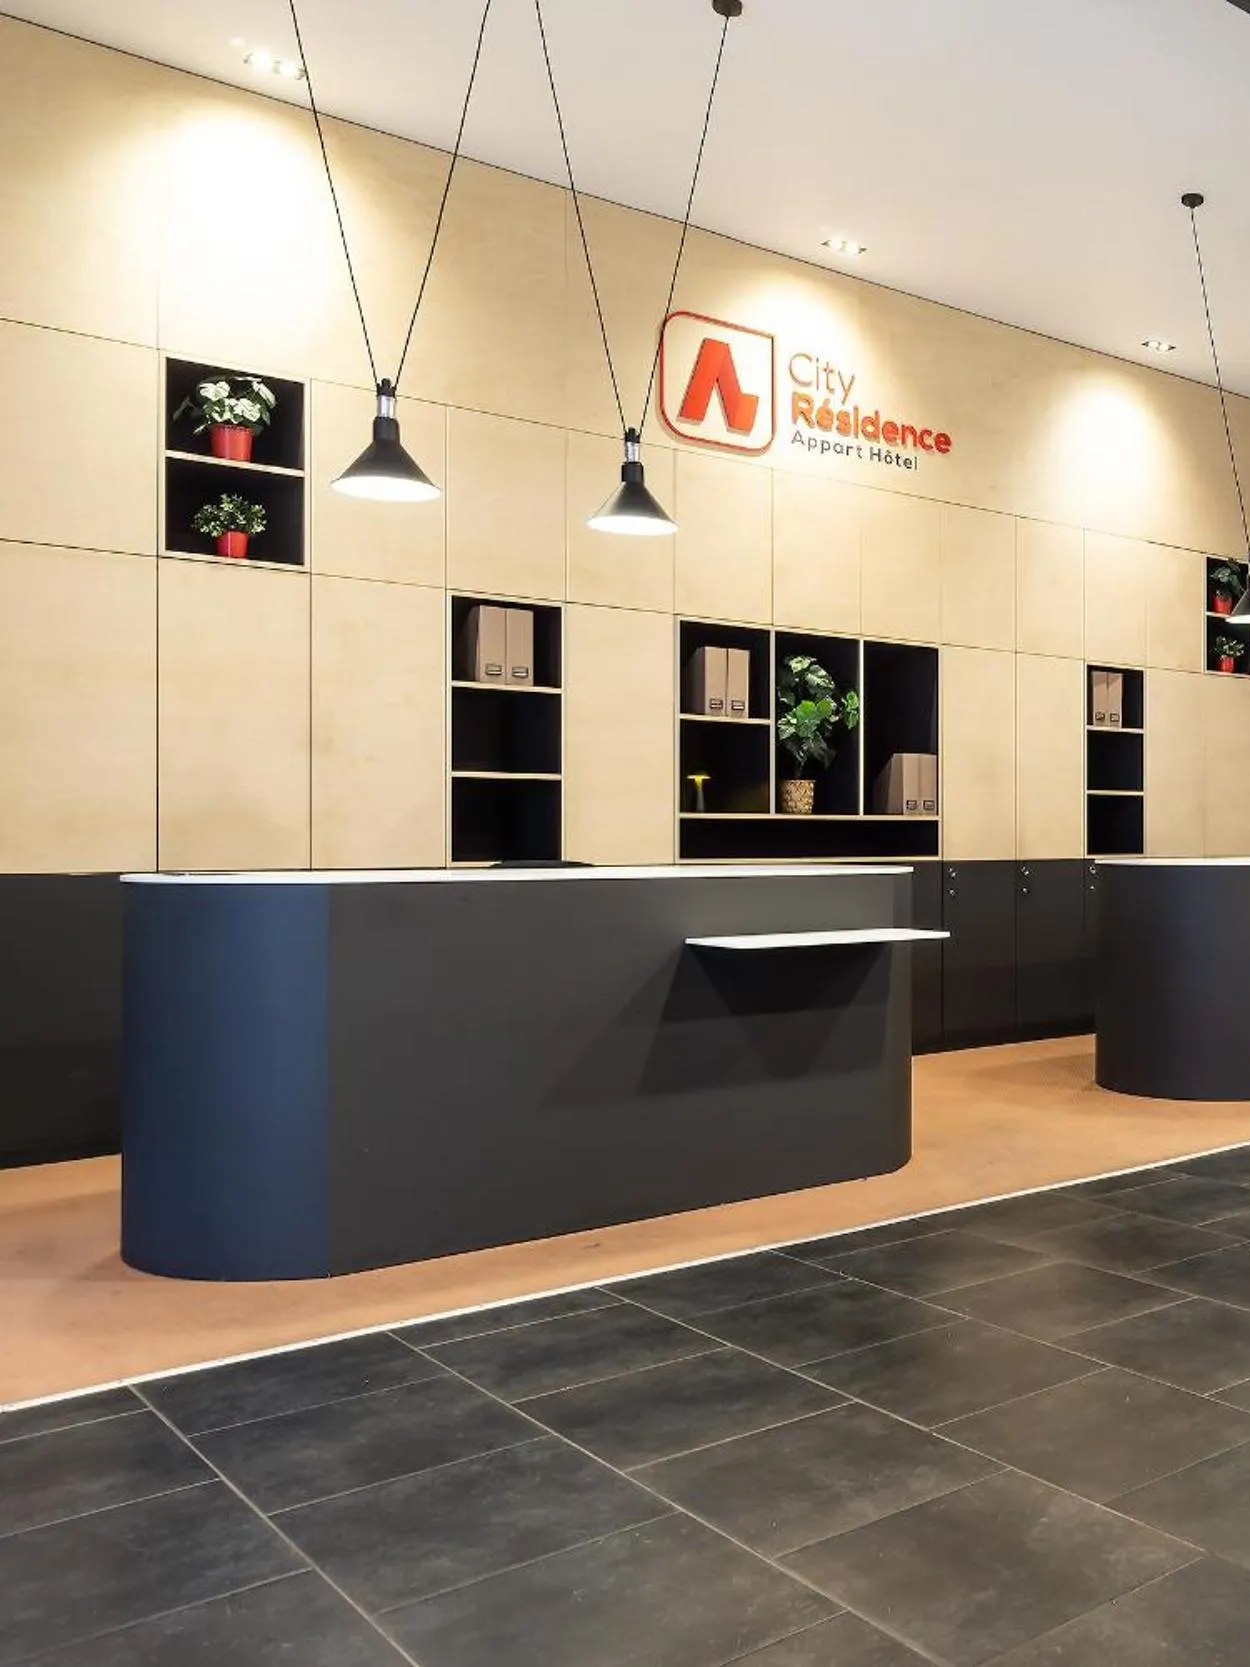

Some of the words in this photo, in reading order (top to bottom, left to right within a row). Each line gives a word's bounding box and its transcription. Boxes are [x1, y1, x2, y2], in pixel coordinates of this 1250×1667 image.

[788, 352, 855, 405] City
[791, 391, 953, 454] Résidence
[791, 429, 864, 459] Appart
[869, 447, 919, 470] Hôtel
